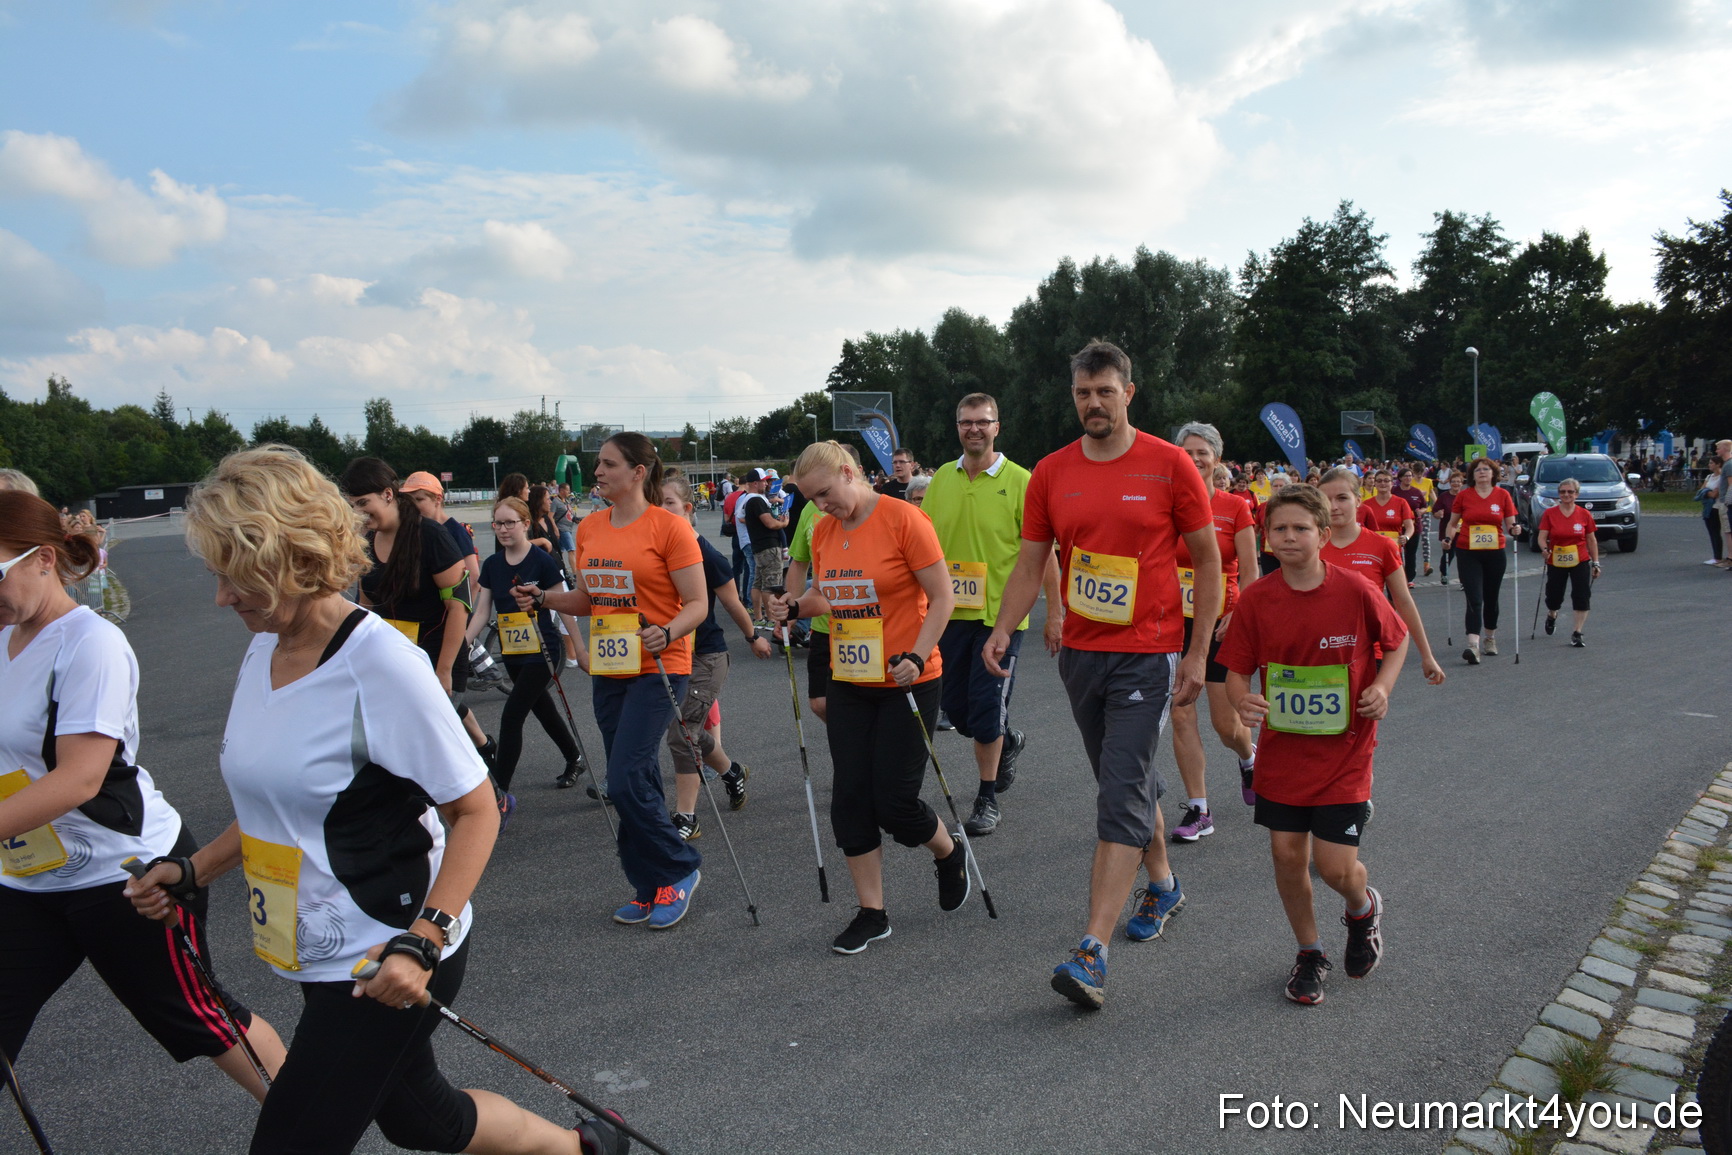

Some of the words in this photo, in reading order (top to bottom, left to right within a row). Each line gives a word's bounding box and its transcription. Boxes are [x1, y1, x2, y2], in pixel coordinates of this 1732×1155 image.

[1475, 535, 1493, 543] 263
[587, 558, 599, 567] 30
[601, 559, 623, 568] Jahre
[1557, 554, 1574, 562] 258
[825, 569, 836, 578] 30
[839, 569, 863, 577] Jahre
[585, 574, 628, 589] OBI
[952, 579, 977, 596] 210
[822, 585, 870, 600] OBI
[1075, 575, 1129, 606] 1052
[831, 604, 882, 619] eumarkt
[506, 628, 530, 643] 724
[1329, 634, 1358, 643] Petry
[597, 638, 628, 658] 583
[838, 644, 870, 665] 550
[1274, 692, 1342, 716] 1053
